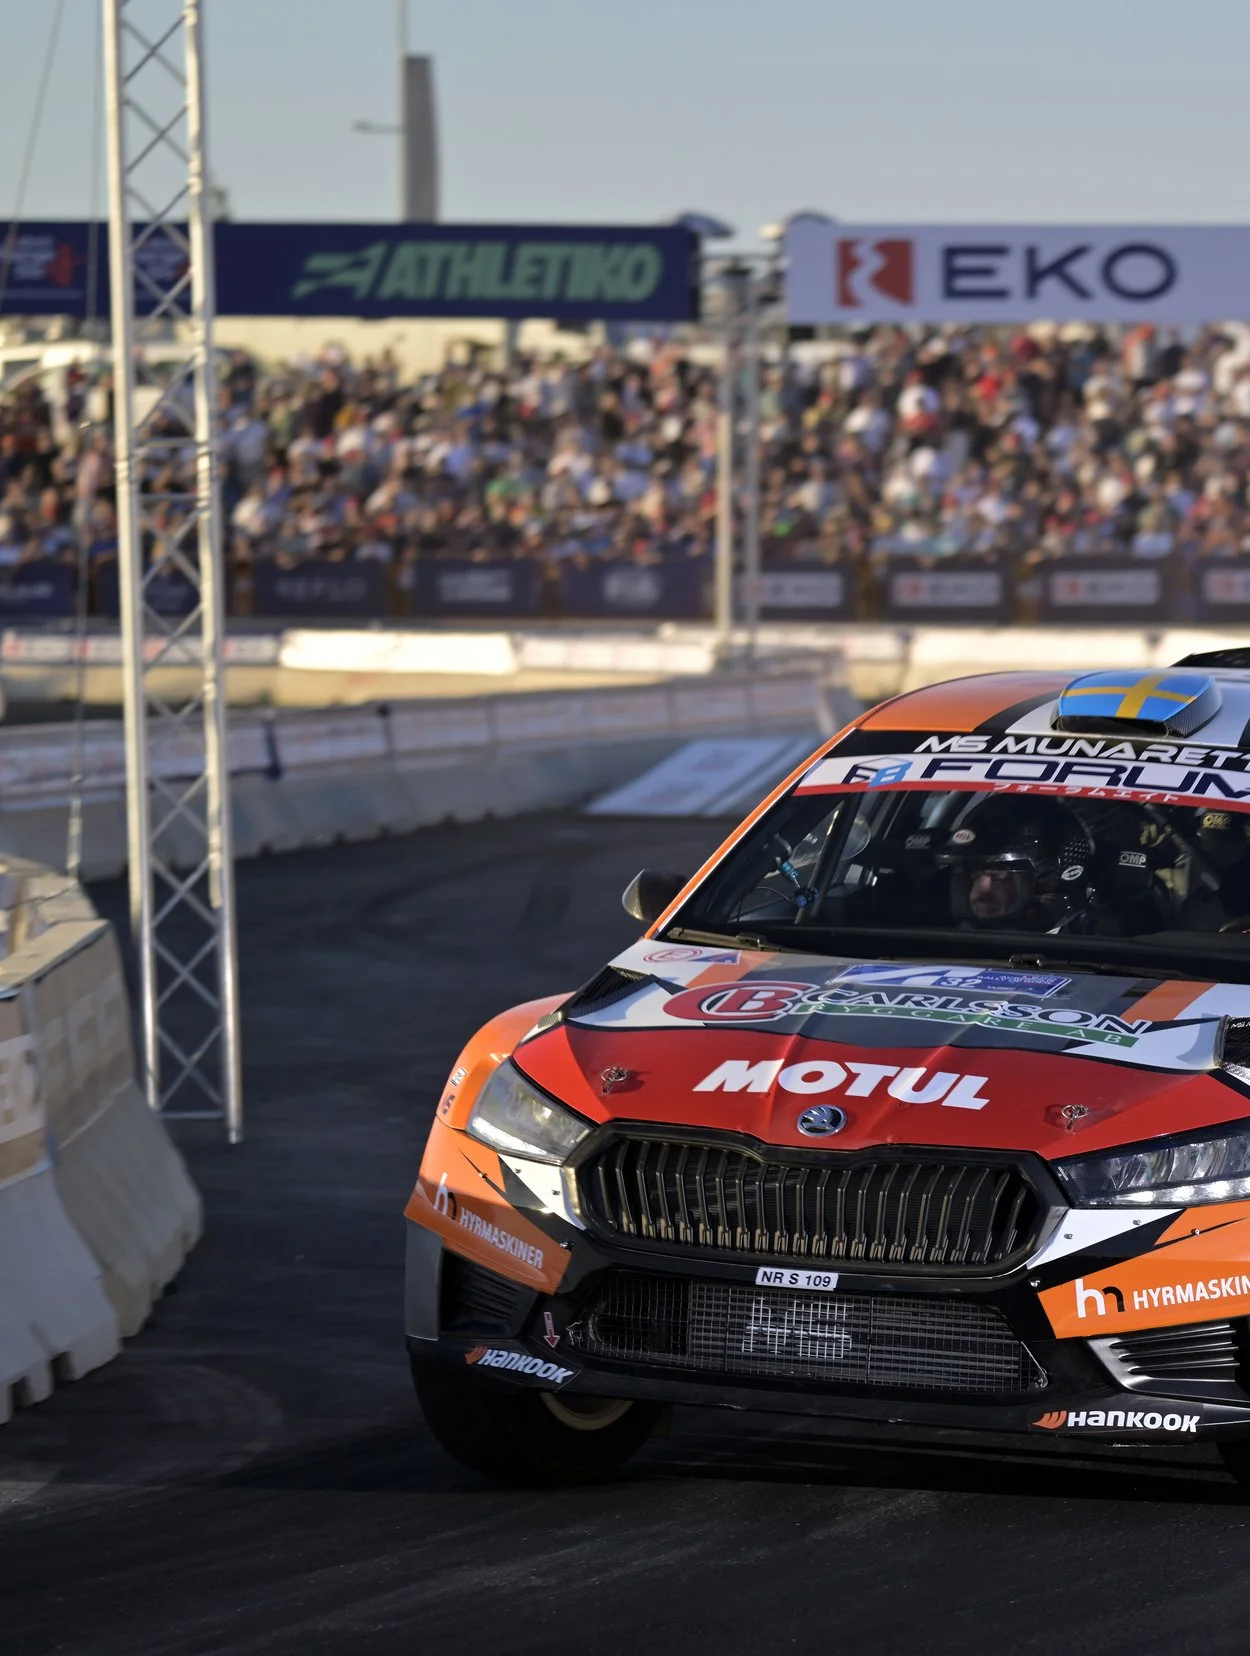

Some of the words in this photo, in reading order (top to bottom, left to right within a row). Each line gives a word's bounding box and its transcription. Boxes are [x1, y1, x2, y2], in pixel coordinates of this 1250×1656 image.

[379, 242, 662, 300] ATHLETIKO
[943, 242, 1178, 301] EKO
[913, 735, 992, 754] MS
[1120, 854, 1146, 864] OMP
[940, 977, 983, 988] 32
[802, 989, 1152, 1035] CARLSSON
[811, 1003, 1032, 1031] BYGGARE
[1066, 1028, 1122, 1045] AB
[692, 1058, 990, 1110] MOTUL
[460, 1206, 545, 1270] HYRMASKINER
[761, 1271, 784, 1284] NR
[788, 1273, 800, 1285] S
[806, 1275, 832, 1287] 109
